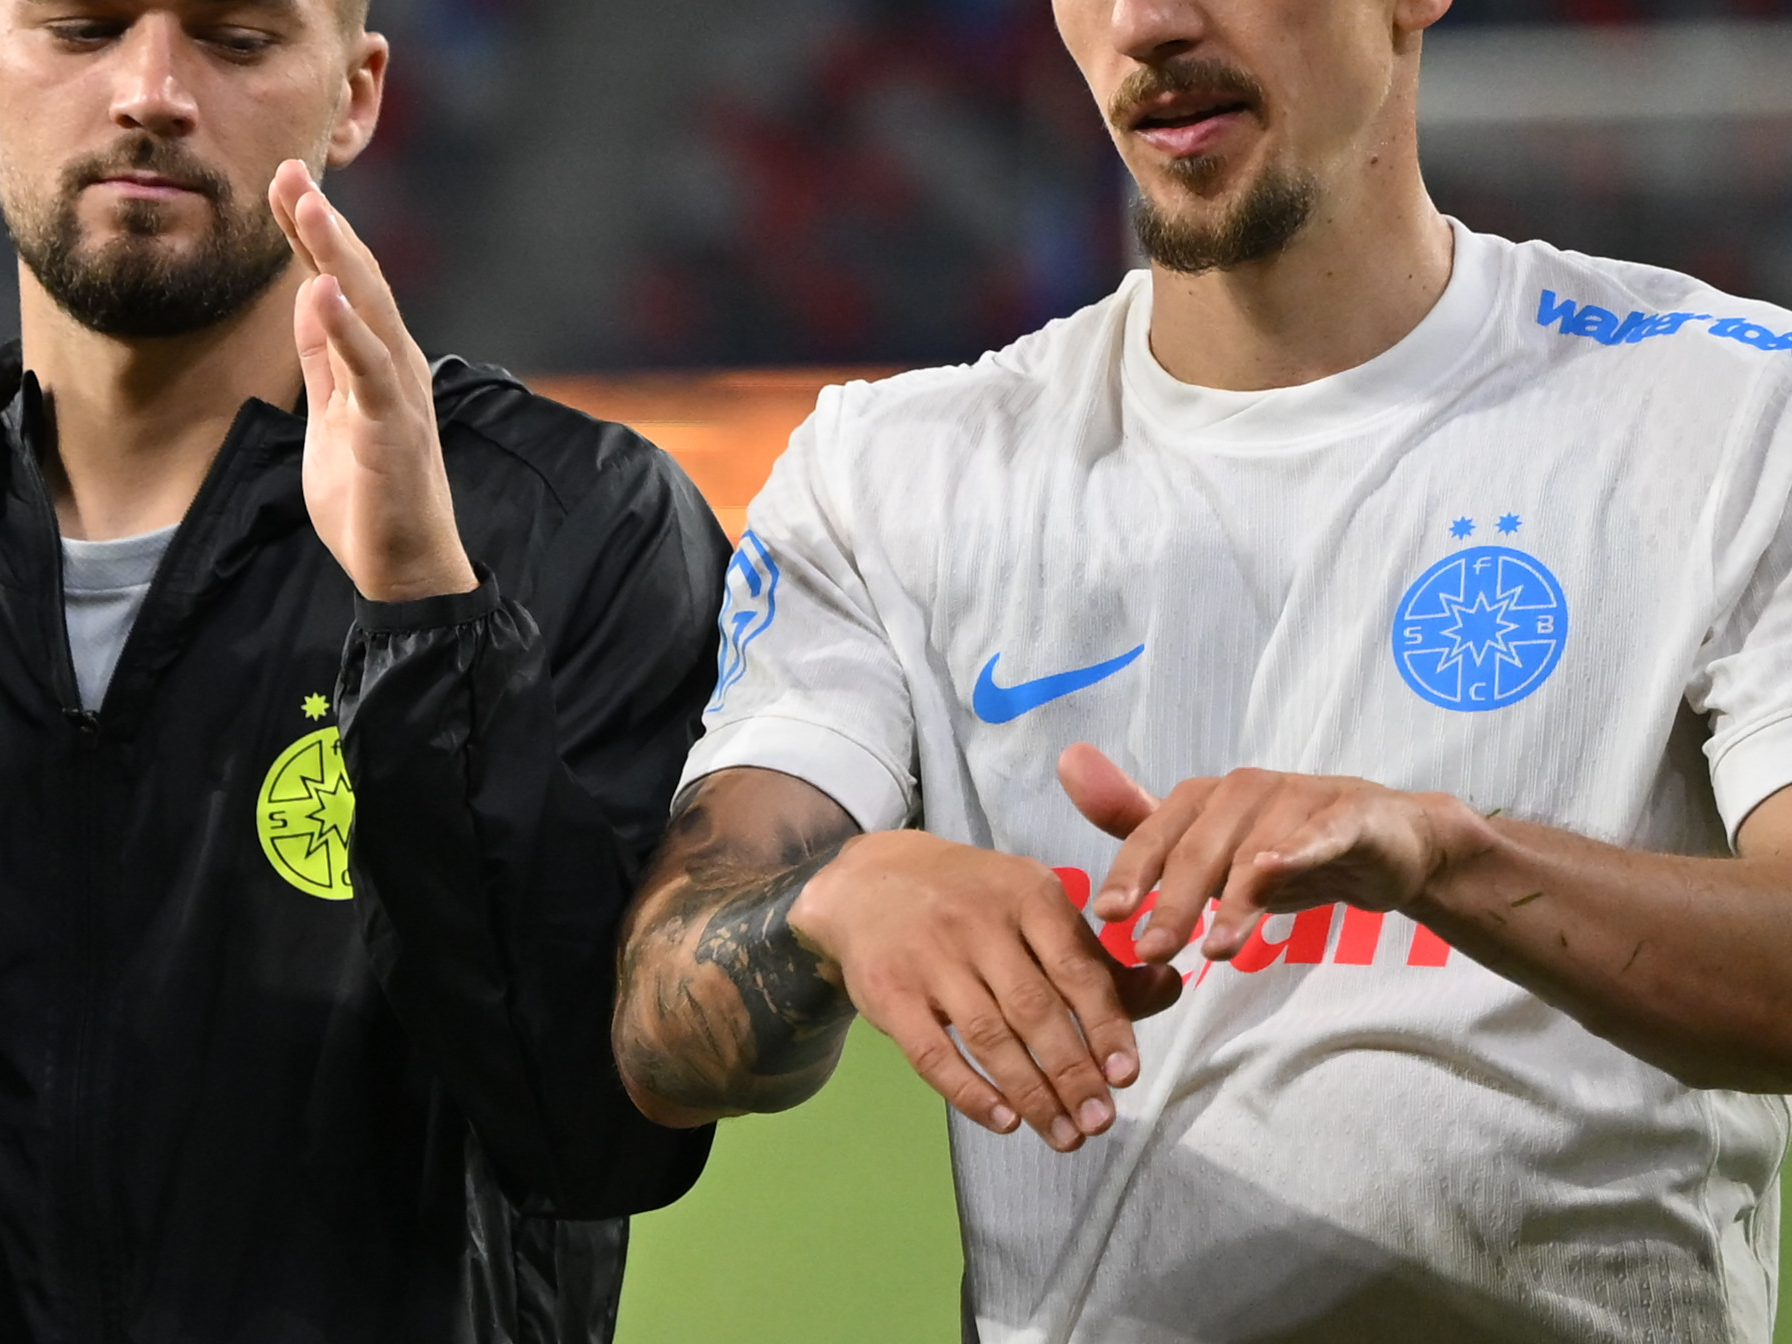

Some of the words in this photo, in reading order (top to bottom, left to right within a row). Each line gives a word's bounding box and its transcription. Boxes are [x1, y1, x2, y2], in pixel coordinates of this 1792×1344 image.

[1536, 614, 1555, 635] B
[1403, 626, 1423, 646] S
[1468, 682, 1487, 702] C
[267, 810, 289, 830] S
